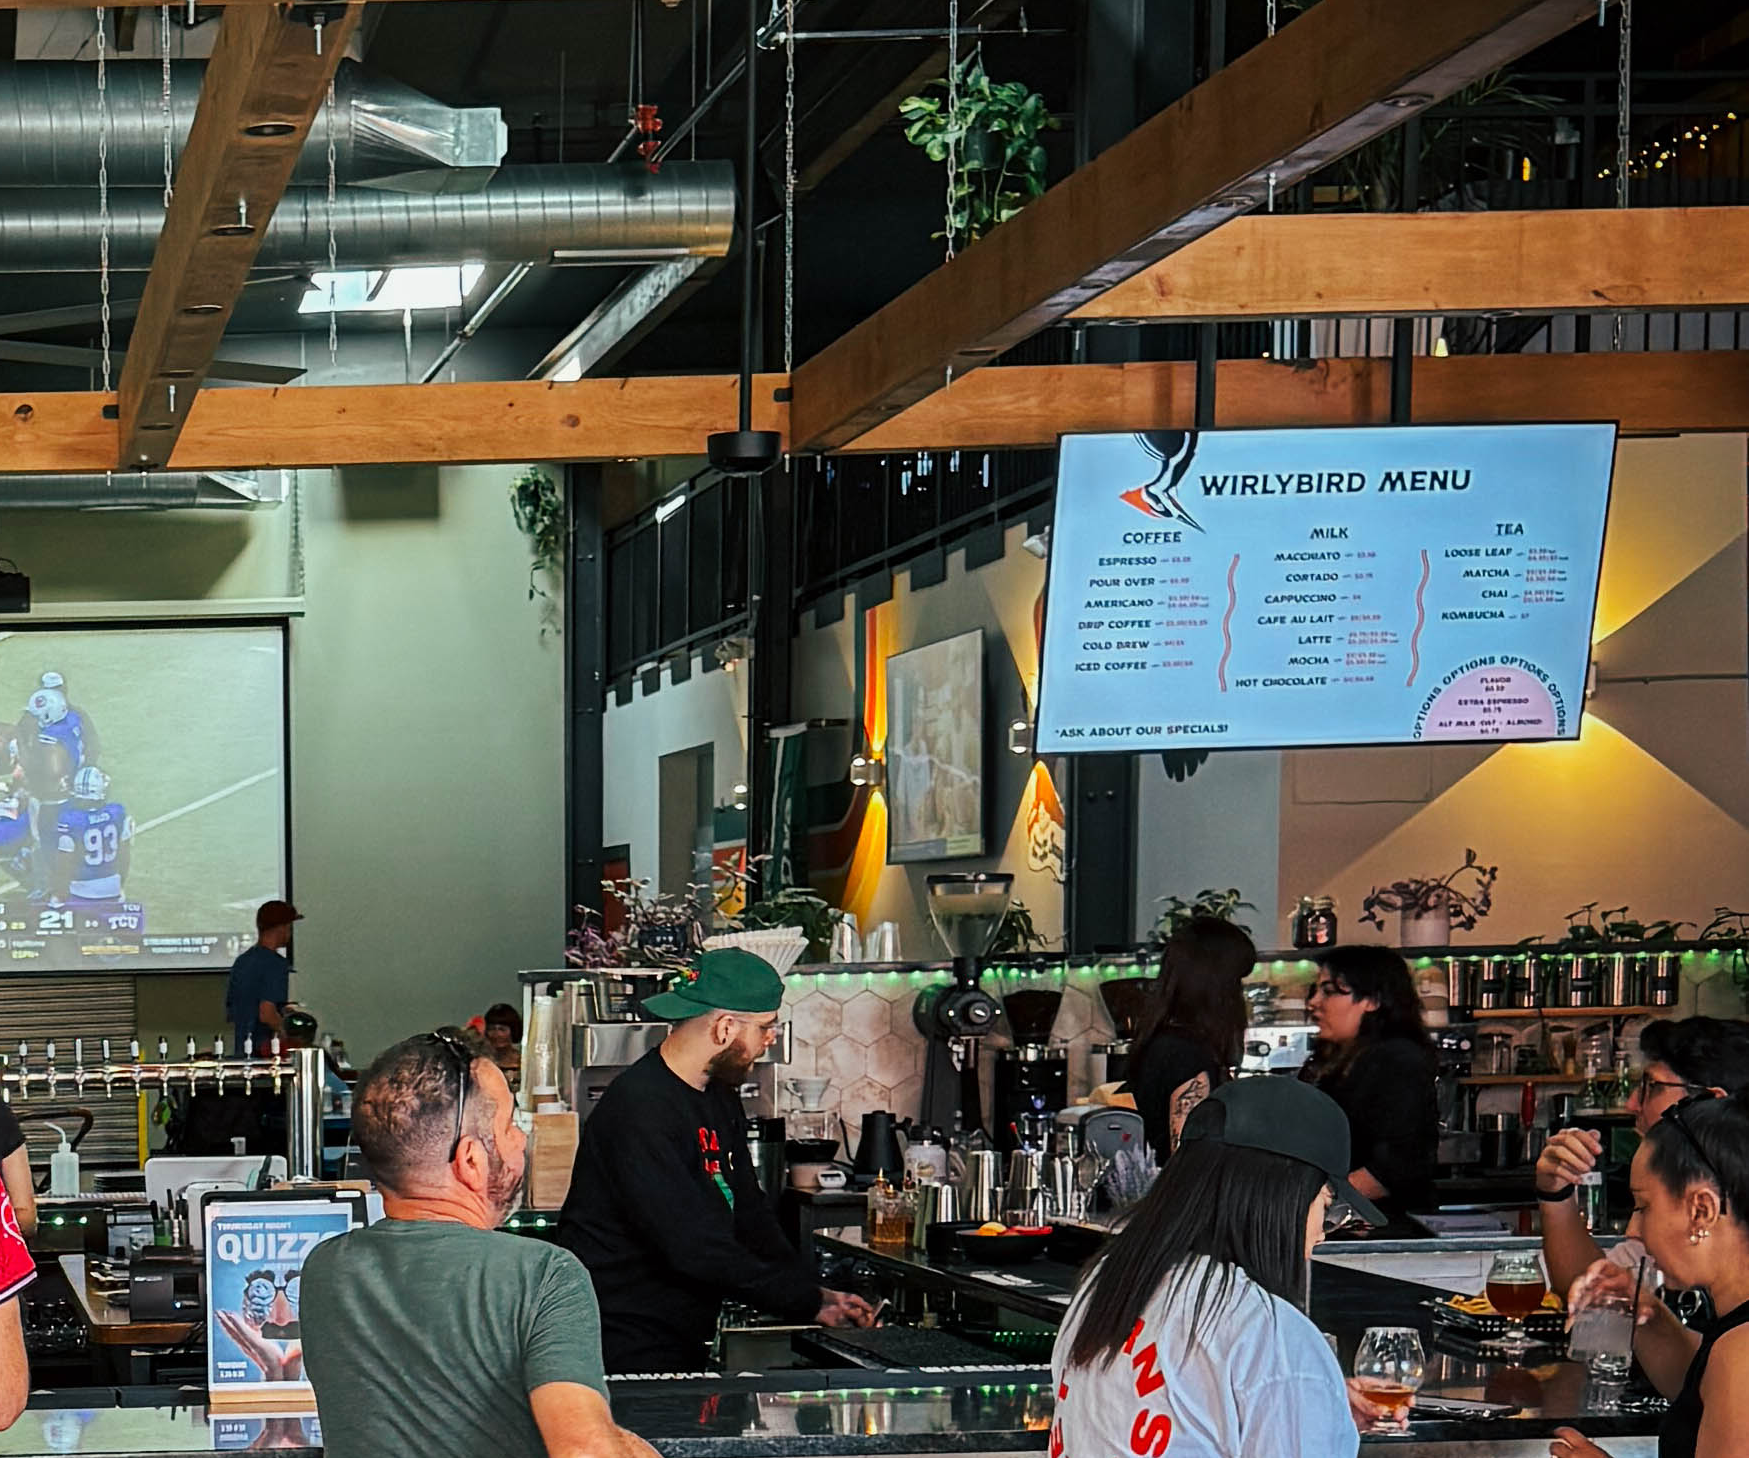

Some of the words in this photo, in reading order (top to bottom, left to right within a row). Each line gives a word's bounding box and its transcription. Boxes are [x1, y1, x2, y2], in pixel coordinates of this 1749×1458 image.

[1200, 471, 1366, 497] WIRLYBIRD
[1378, 469, 1471, 494] MENU
[1309, 527, 1349, 540] MILK
[1495, 523, 1524, 537] TEA
[1123, 531, 1182, 545] COFFEE
[1274, 551, 1341, 562] MACCHIATO
[1444, 548, 1482, 558] LOOSE
[1485, 547, 1513, 557] LEAF
[1098, 556, 1157, 567] ESPRESSO
[1285, 572, 1339, 583] CORTADO
[1462, 568, 1510, 578] MATCHA
[1089, 578, 1121, 588] POUR
[1124, 577, 1155, 587] OVER
[1264, 594, 1337, 604] CAPPUCCINO
[1481, 589, 1508, 599] CHAI
[1084, 598, 1154, 609] AMERICANO
[1257, 616, 1287, 625] CAFE
[1290, 616, 1307, 625] AU
[1309, 614, 1335, 624] LAIT
[1441, 610, 1505, 620] KOMBUCHA
[1078, 620, 1105, 630] DRIP
[1108, 619, 1152, 629] COFFEE
[1082, 641, 1113, 651] COLD
[1116, 640, 1150, 649] BREW
[1298, 635, 1333, 645] LATTE
[1075, 662, 1101, 672] ICED
[1104, 661, 1148, 671] COFFEE
[1288, 656, 1330, 666] MOCHA
[1235, 678, 1259, 687] HOT
[1262, 676, 1328, 687] CHOCOLATE
[1413, 686, 1442, 740] OPTIONS
[1443, 655, 1496, 686] OPTIONS
[1500, 654, 1550, 684] OPTIONS
[1548, 682, 1566, 736] OPTIONS
[1089, 726, 1133, 737] ABOUT
[1136, 725, 1163, 735] OUR
[1167, 724, 1229, 735] SPECIALS!
[84, 824, 118, 866] 93
[39, 910, 74, 929] 21
[108, 915, 139, 930] TCU
[217, 1231, 340, 1265] QUIZZ
